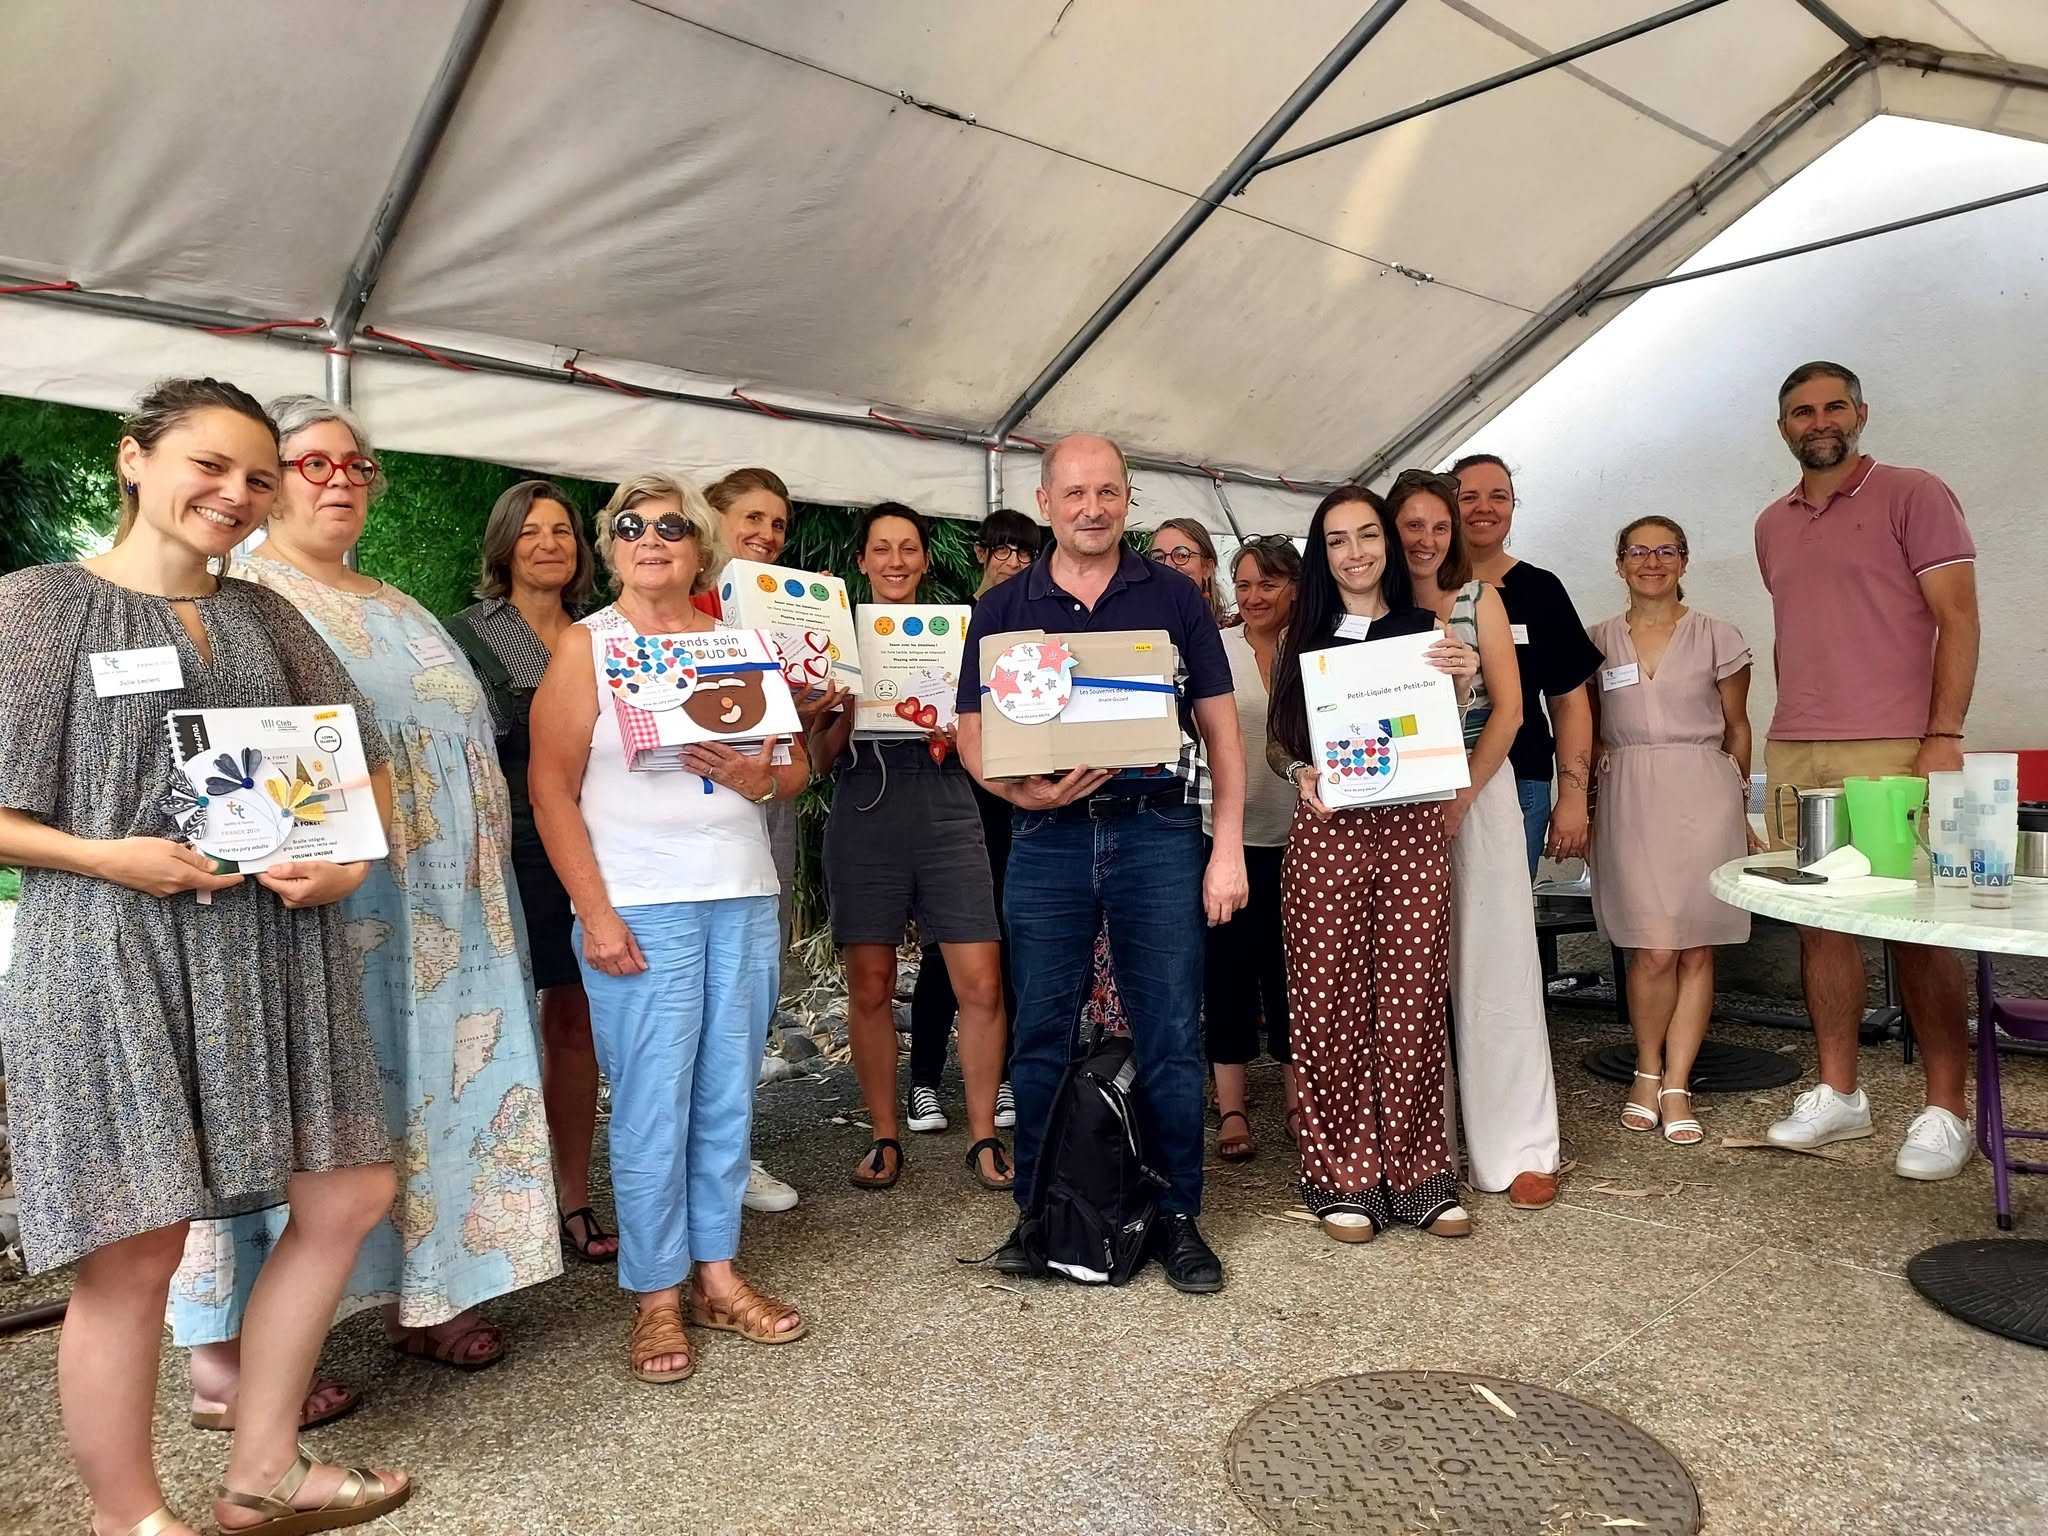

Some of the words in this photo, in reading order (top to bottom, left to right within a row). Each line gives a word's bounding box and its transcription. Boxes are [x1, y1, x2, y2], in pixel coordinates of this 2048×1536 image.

[673, 635, 709, 648] rends
[713, 635, 739, 646] soin
[1347, 687, 1392, 700] Petit-Liquide
[1393, 684, 1402, 692] et
[1403, 680, 1436, 690] Petit-Dur
